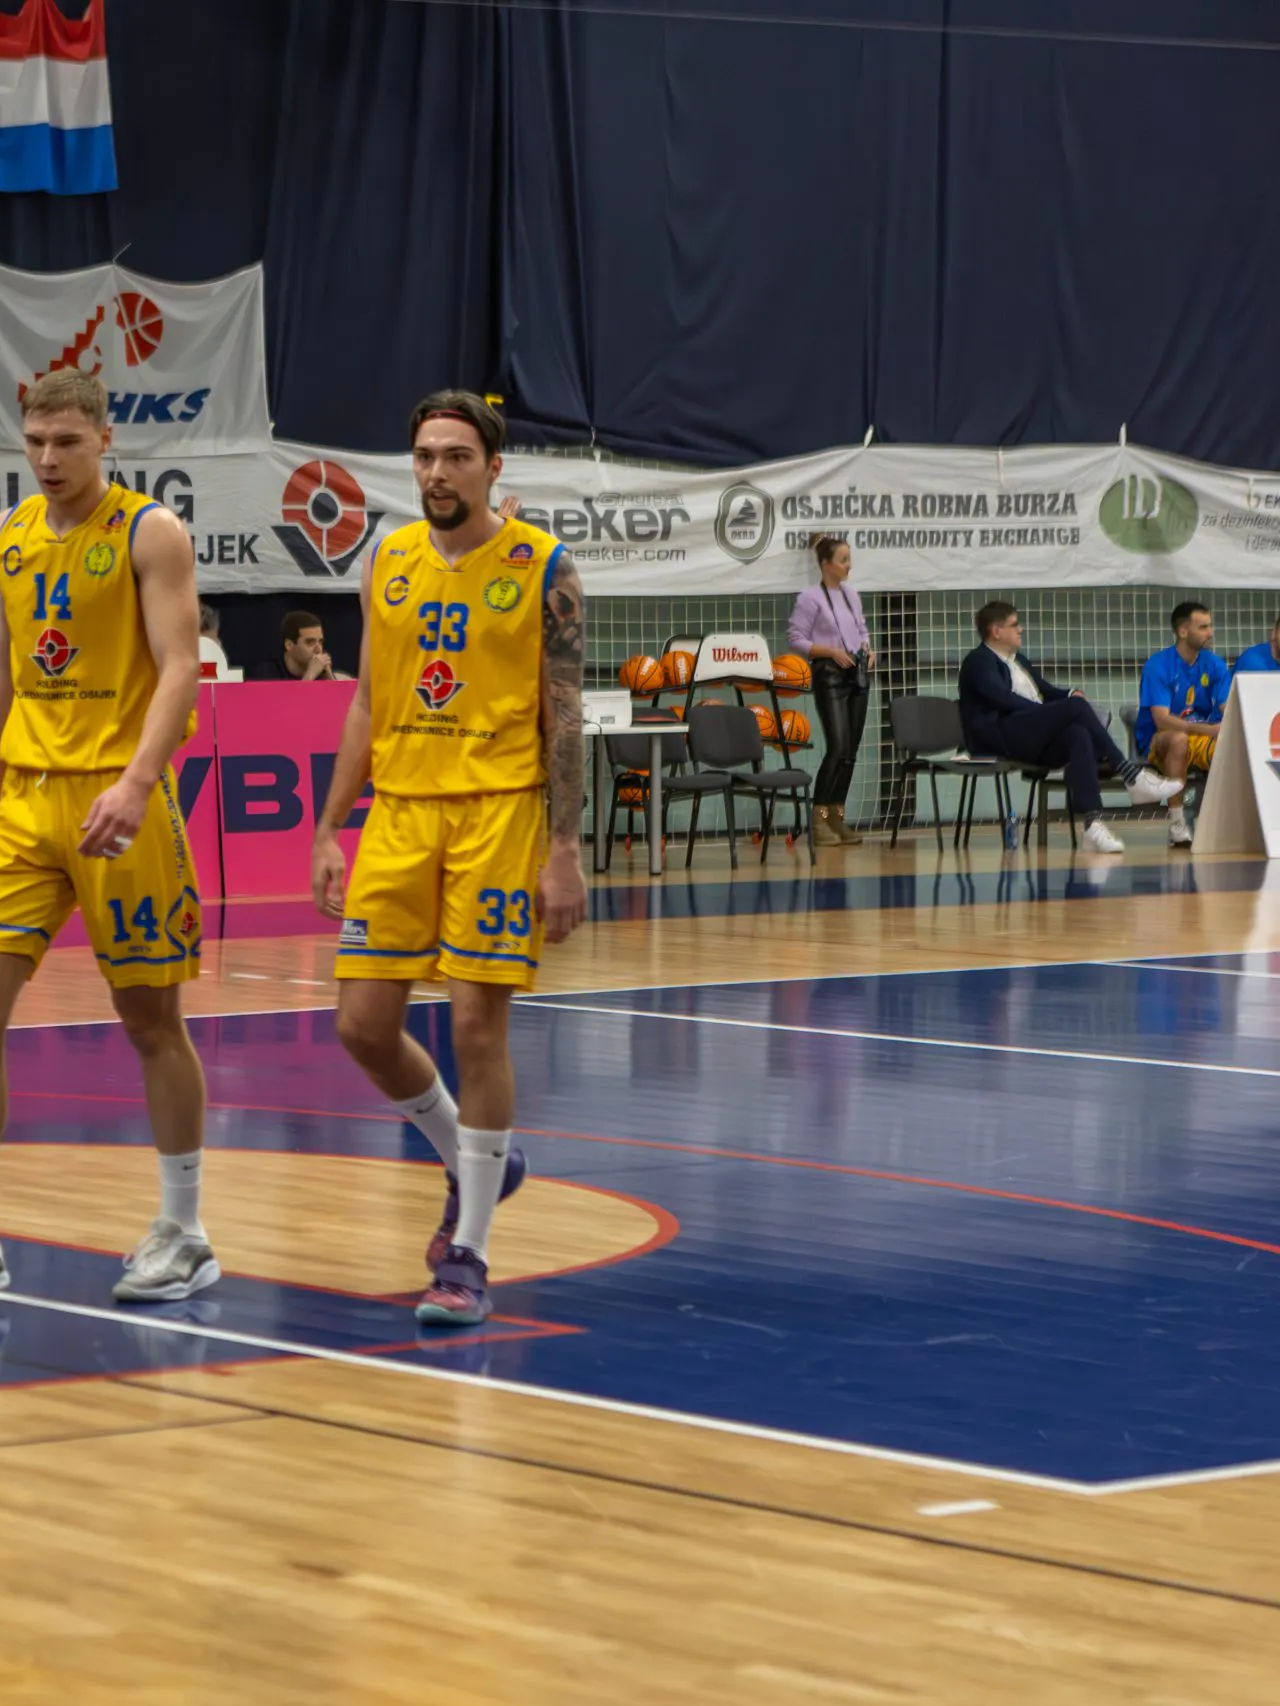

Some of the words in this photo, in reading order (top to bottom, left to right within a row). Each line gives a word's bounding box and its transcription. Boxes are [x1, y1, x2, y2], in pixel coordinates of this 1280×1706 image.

[108, 388, 211, 424] HKS
[781, 485, 896, 521] OSJEČKA
[902, 493, 990, 519] ROBNA
[995, 492, 1078, 518] BURZA
[570, 547, 686, 563] seker.com
[854, 530, 974, 550] COMMODITY
[978, 526, 1081, 548] EXCHANGE
[32, 572, 73, 621] 14
[417, 601, 470, 653] 33
[712, 648, 759, 663] Wilson
[107, 895, 160, 943] 14
[476, 887, 532, 937] 33
